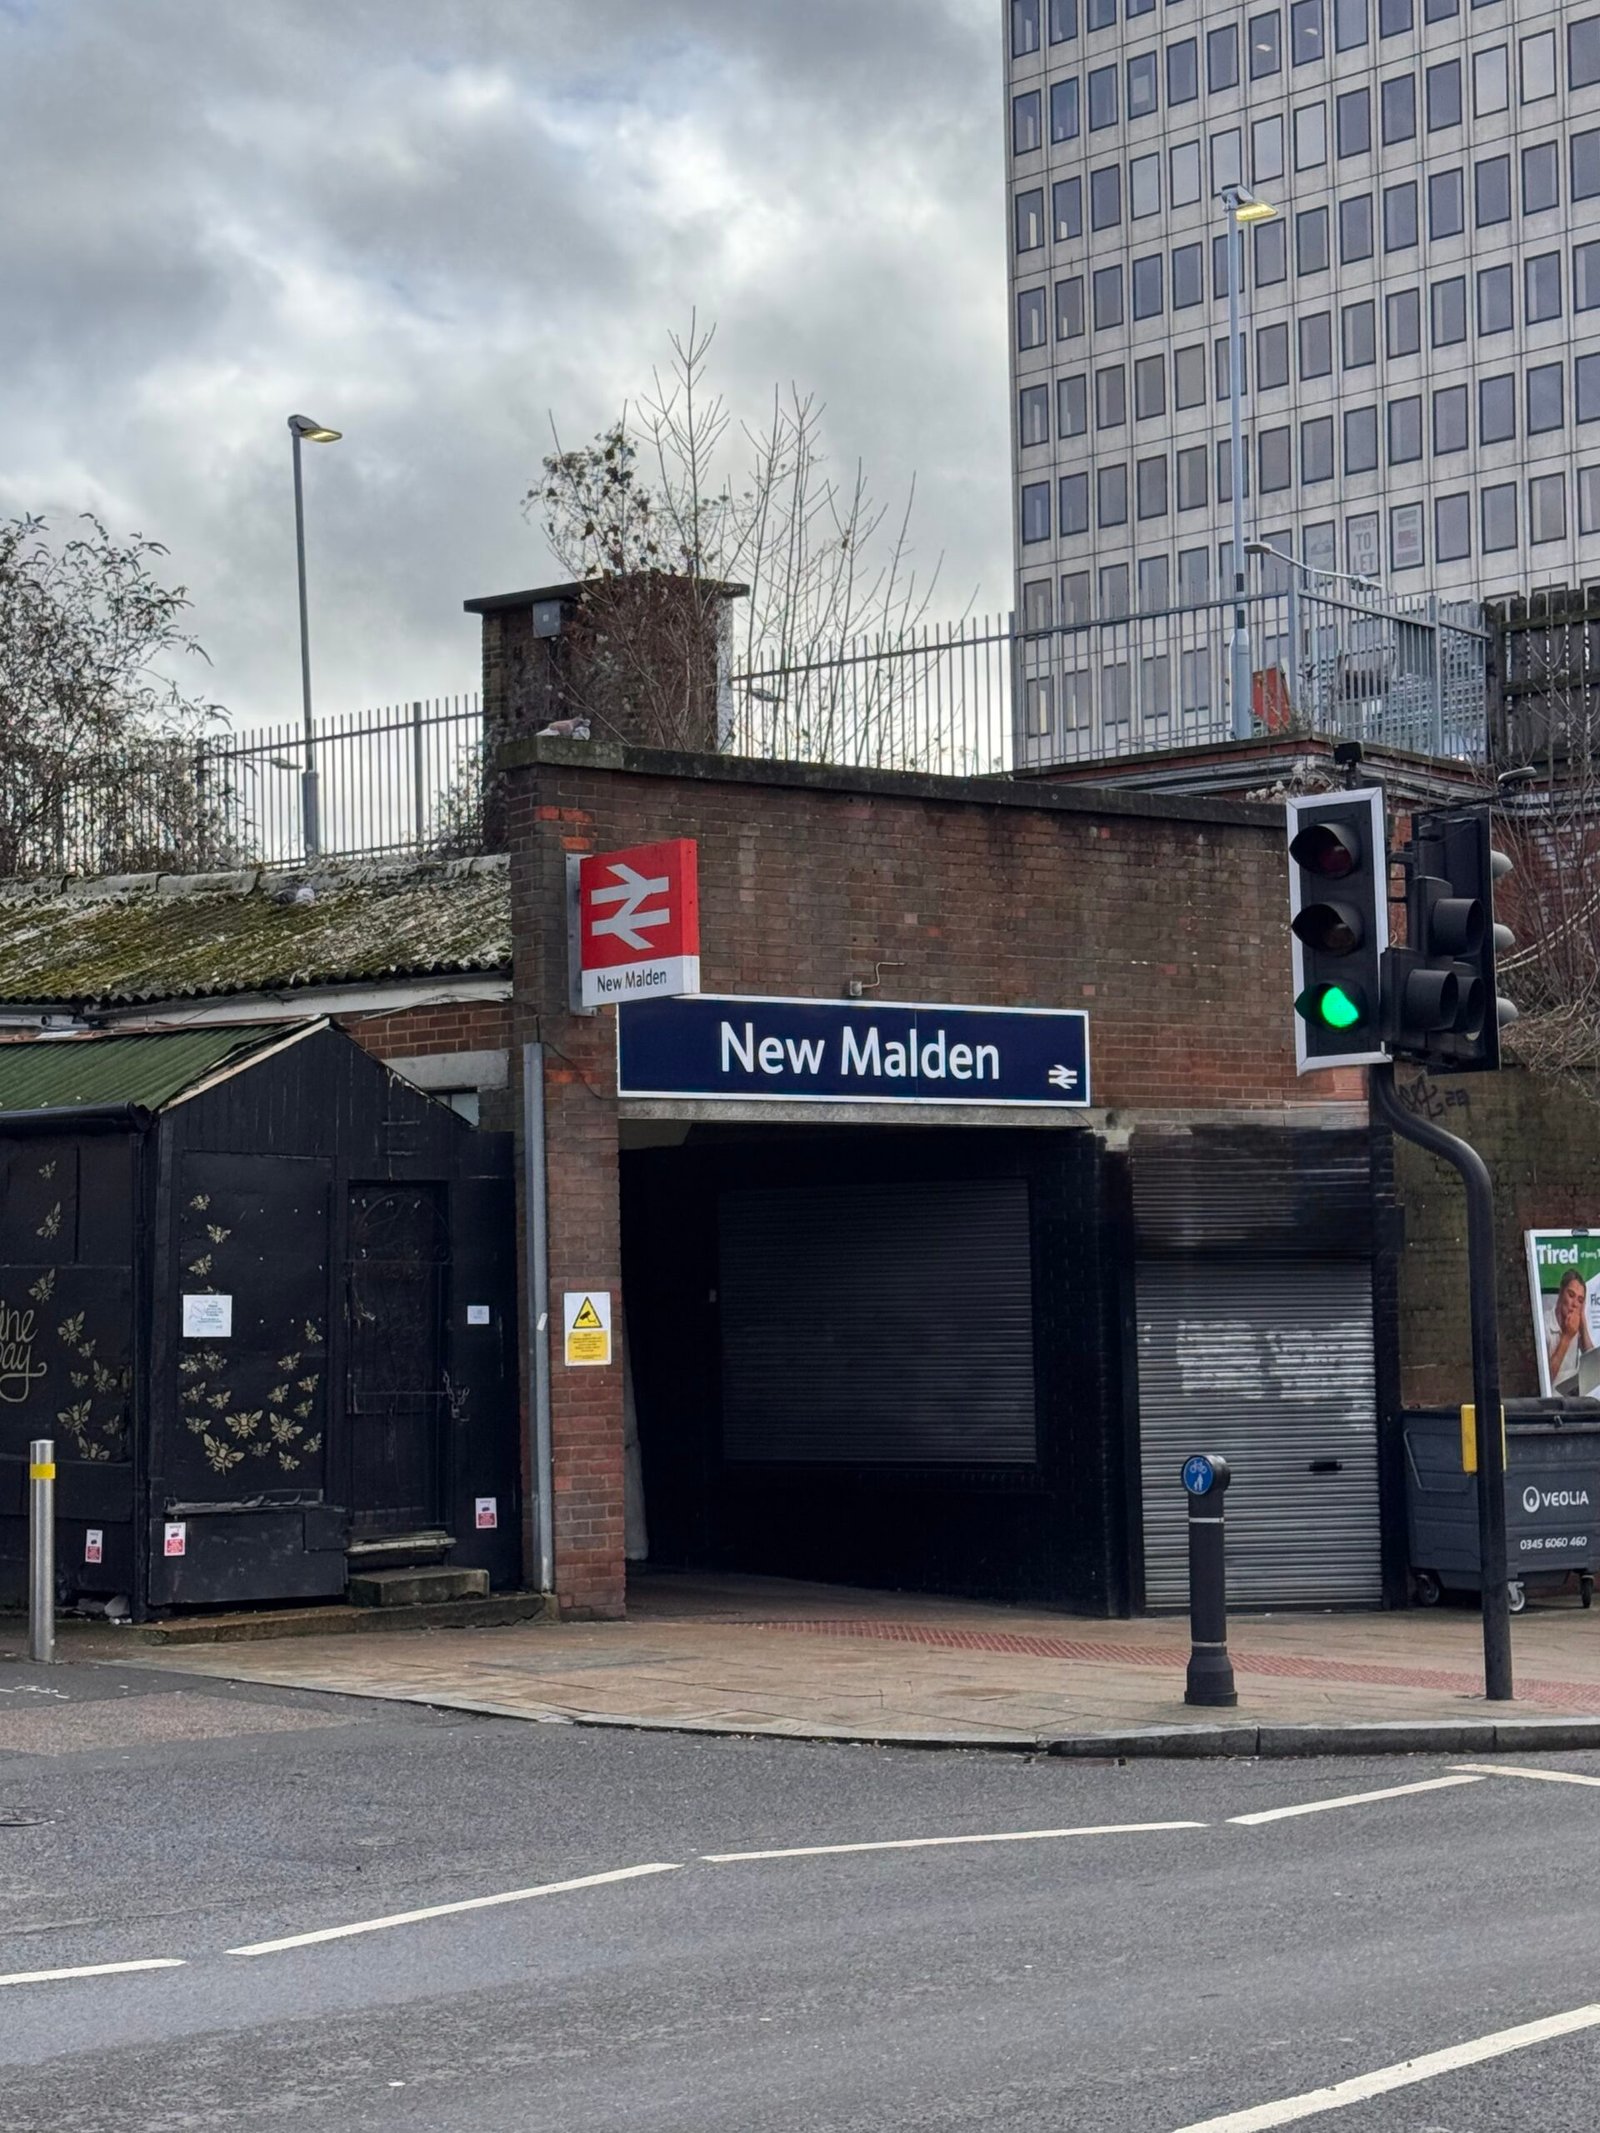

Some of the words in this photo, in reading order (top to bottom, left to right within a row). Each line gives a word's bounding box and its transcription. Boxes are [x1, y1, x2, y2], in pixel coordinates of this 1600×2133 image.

[1355, 532, 1371, 551] TO
[1352, 552, 1375, 573] LET
[597, 974, 623, 993] New
[625, 968, 667, 989] Malden
[720, 1021, 825, 1075] New
[840, 1026, 1000, 1080] Malden
[1536, 1243, 1579, 1265] Tired
[1541, 1490, 1590, 1507] VEOLIA
[1520, 1538, 1543, 1550] 0345
[1545, 1537, 1568, 1548] 6060
[1569, 1536, 1587, 1546] 460
